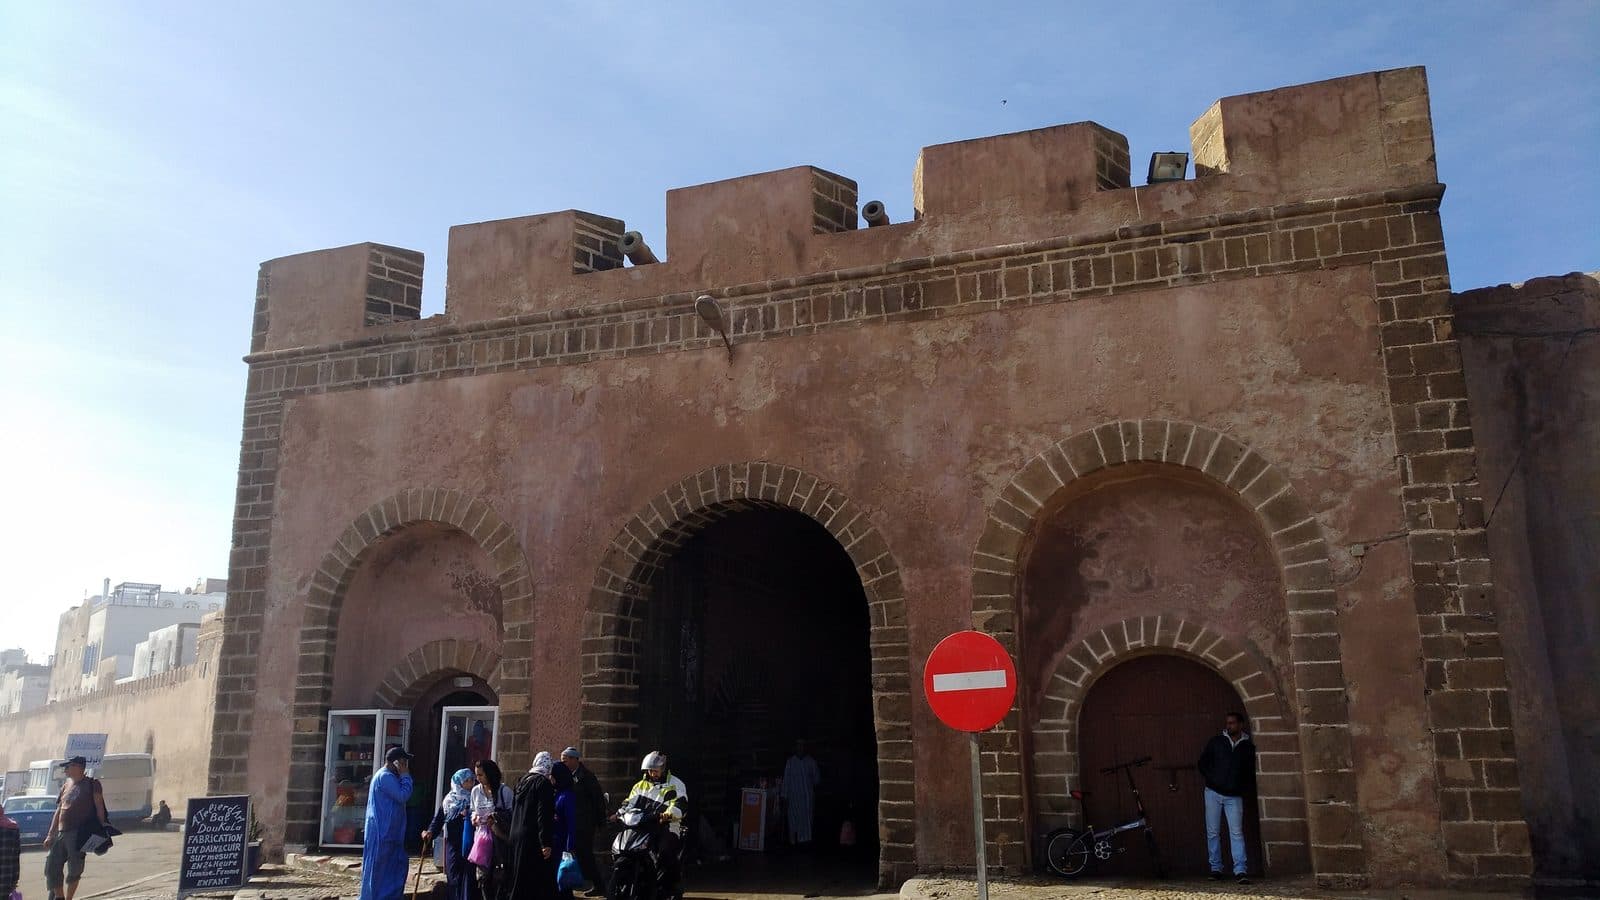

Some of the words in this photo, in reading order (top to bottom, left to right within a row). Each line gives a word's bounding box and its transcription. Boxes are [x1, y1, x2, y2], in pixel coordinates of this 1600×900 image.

[188, 834, 242, 844] FABRICATION
[186, 846, 198, 854] EN
[197, 878, 230, 886] ENFANT
